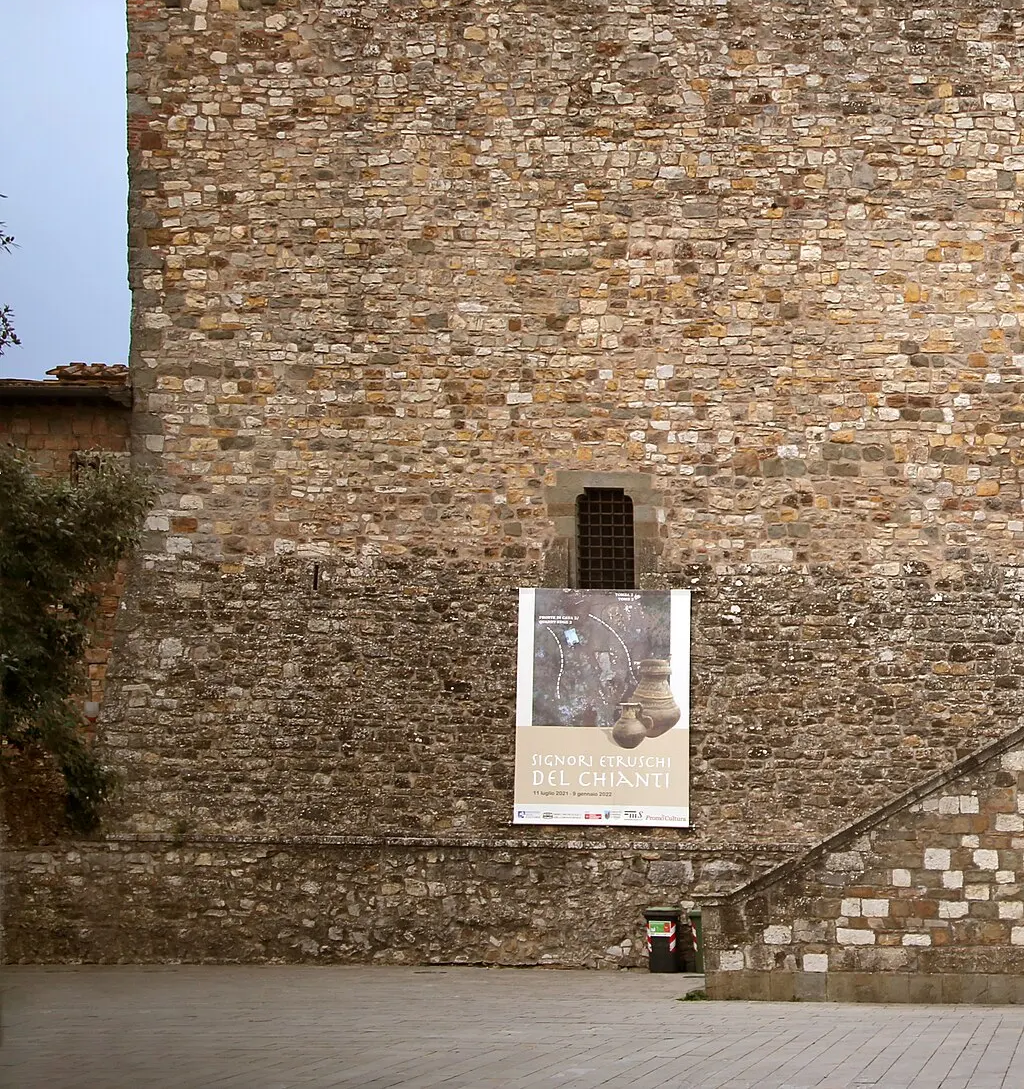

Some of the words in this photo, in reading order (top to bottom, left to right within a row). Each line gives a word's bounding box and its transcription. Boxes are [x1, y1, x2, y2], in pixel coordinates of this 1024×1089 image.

[532, 754, 593, 767] SIGNORI
[599, 755, 671, 768] ETRUSCHI
[532, 770, 570, 786] DEL
[578, 771, 669, 788] CHIANTI
